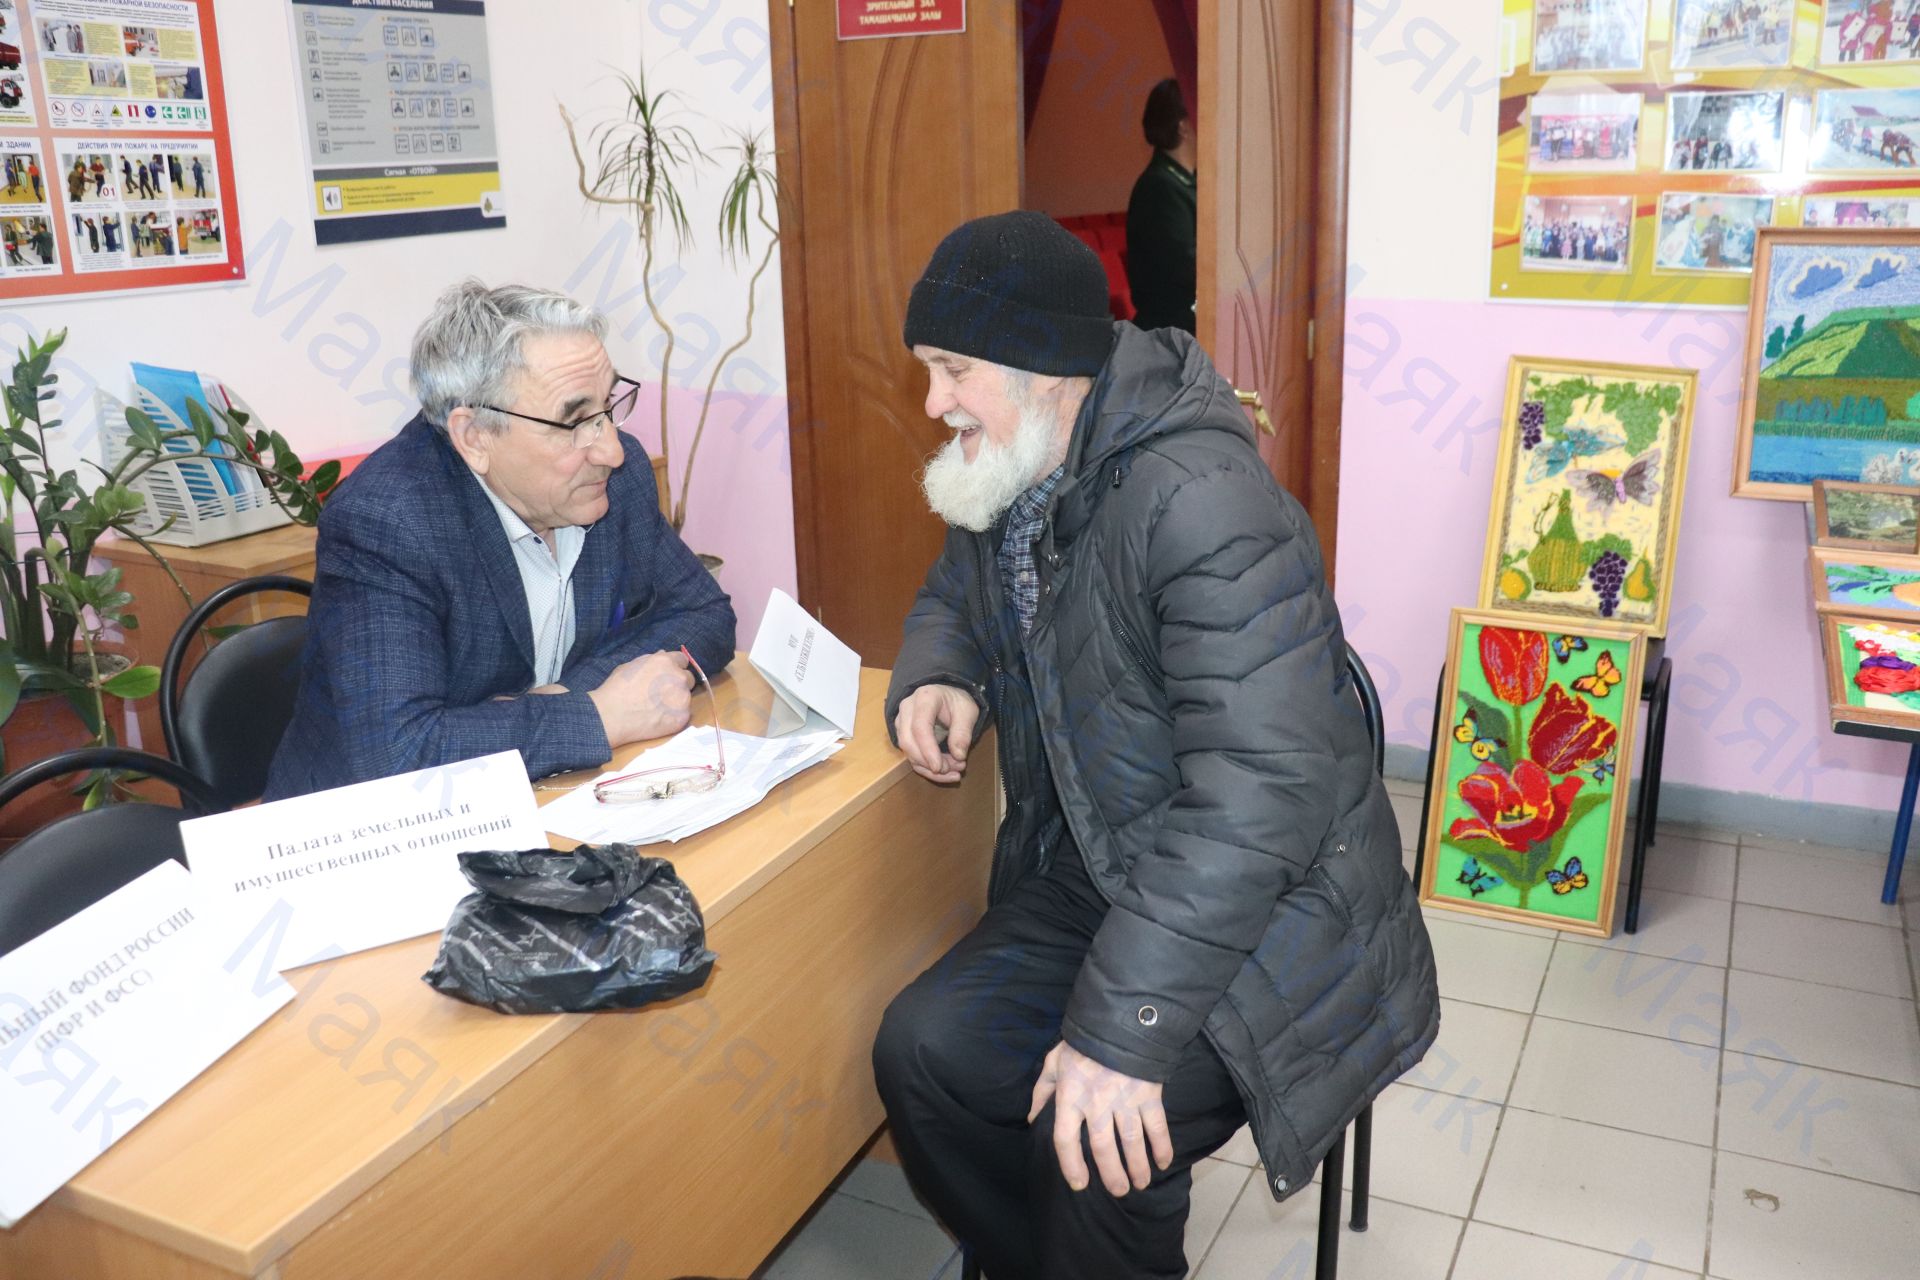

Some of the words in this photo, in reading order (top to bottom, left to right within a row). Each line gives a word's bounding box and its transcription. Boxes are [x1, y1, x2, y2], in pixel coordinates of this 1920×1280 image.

[6, 141, 32, 149] ЗДАНИИ
[77, 142, 109, 150] ДЕЙСТВИЯ
[110, 142, 123, 150] ПРИ
[124, 142, 149, 150] ПОЖАРЕ
[150, 142, 159, 150] НА
[102, 186, 116, 197] 01
[267, 832, 343, 860] Палата
[351, 808, 454, 841] земельных
[460, 802, 471, 815] и
[407, 814, 513, 851] отношений
[69, 953, 127, 995] ФОНД
[124, 907, 195, 960] РОССИИ
[85, 999, 105, 1018] И
